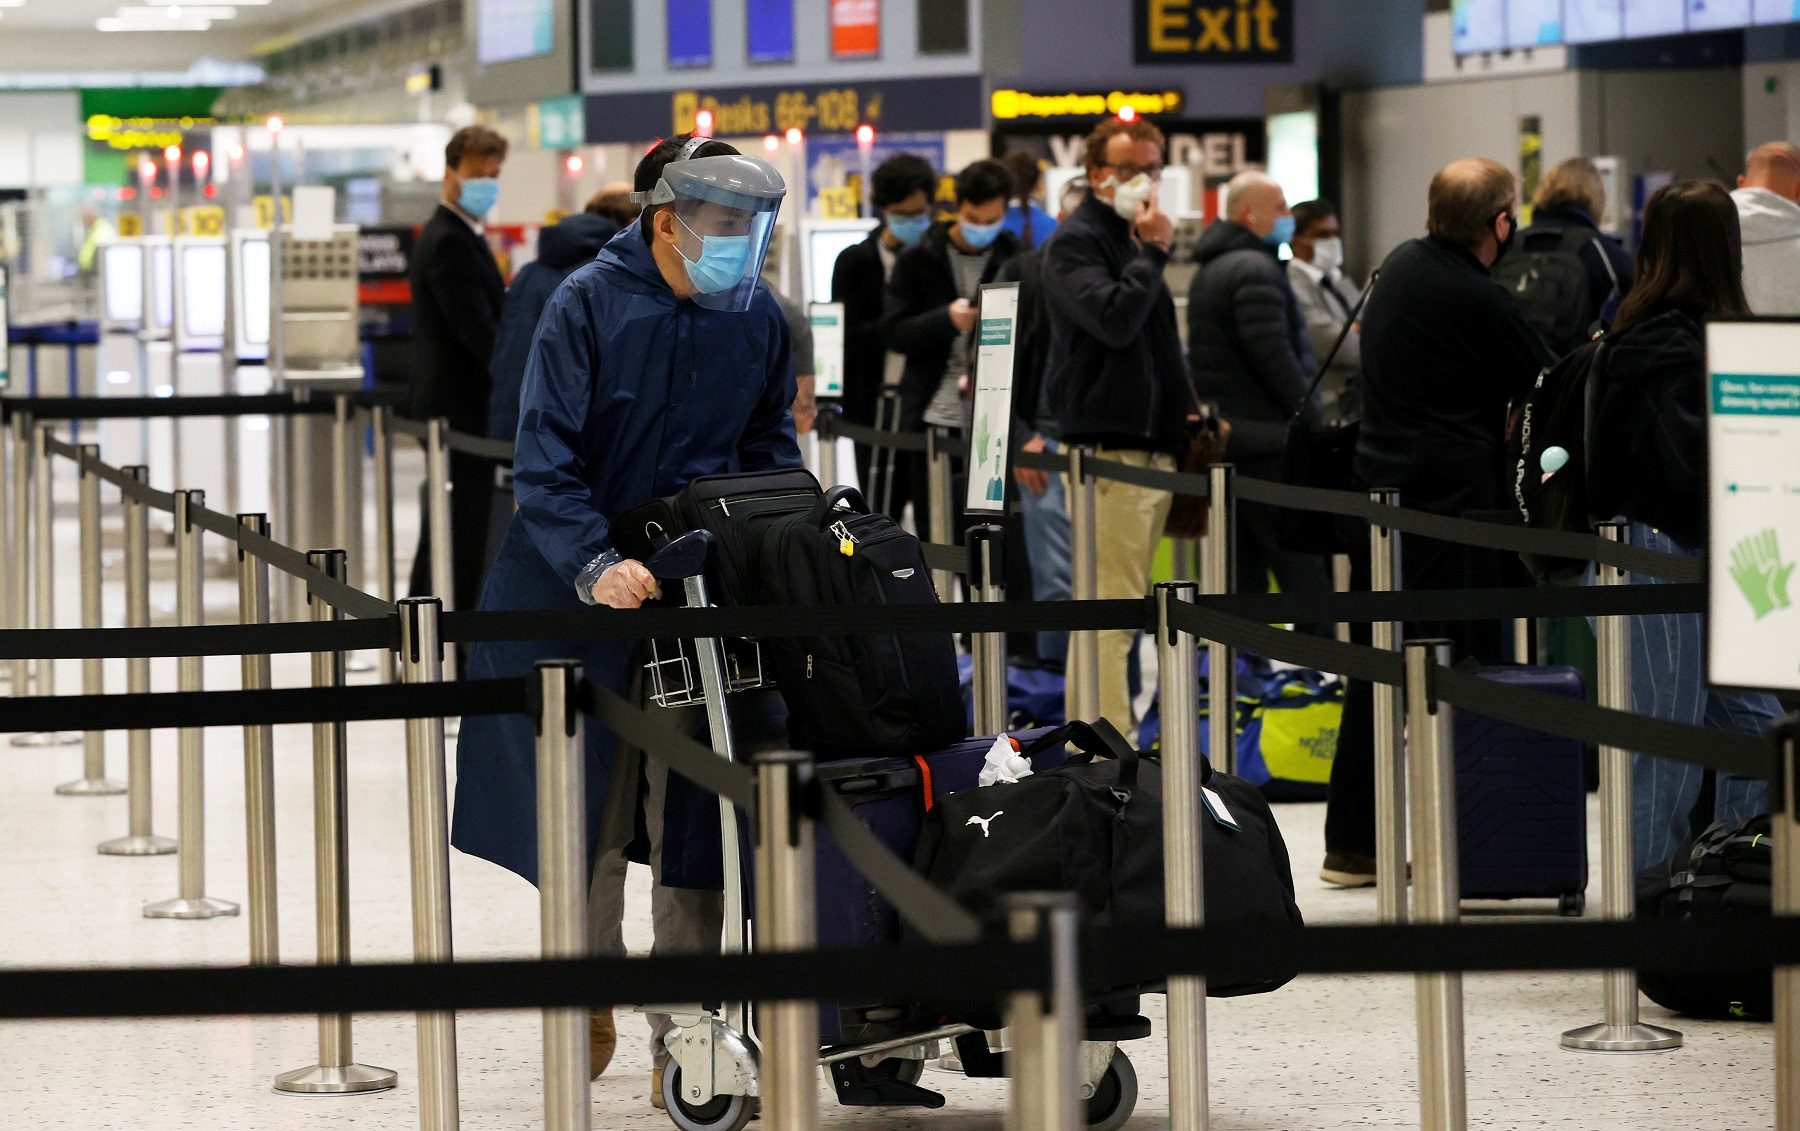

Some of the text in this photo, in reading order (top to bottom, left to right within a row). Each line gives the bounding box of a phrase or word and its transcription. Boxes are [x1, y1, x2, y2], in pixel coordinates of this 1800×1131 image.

[1149, 0, 1278, 51] Exit
[1514, 403, 1533, 523] UNDER ARMOUR
